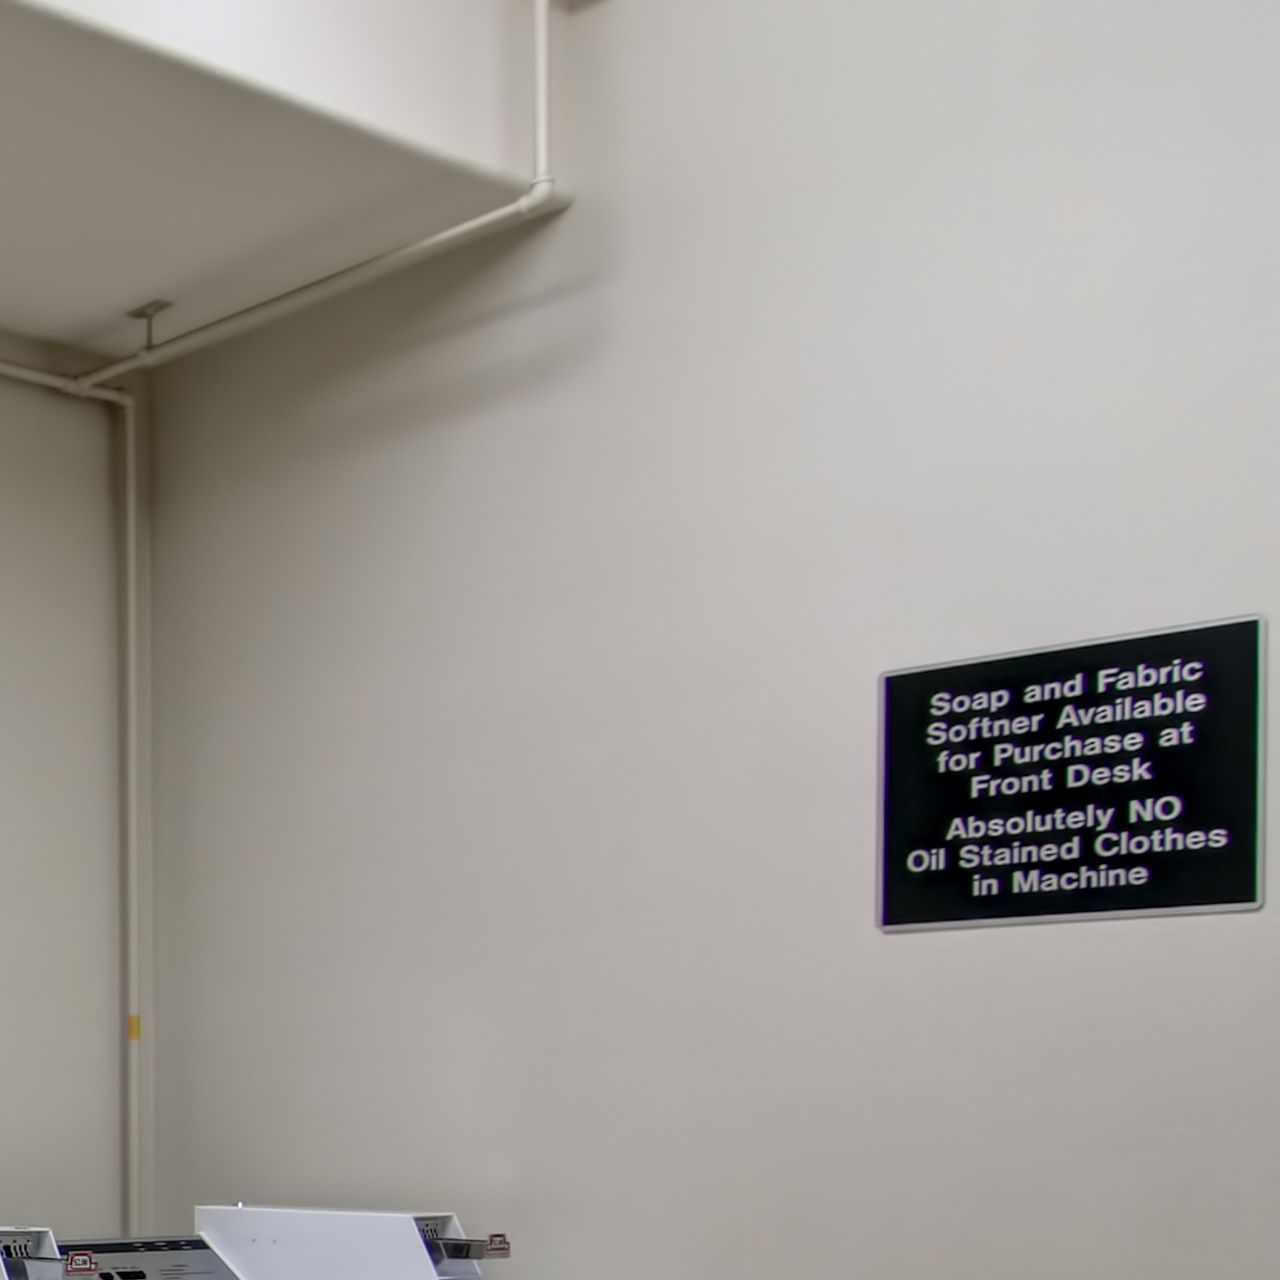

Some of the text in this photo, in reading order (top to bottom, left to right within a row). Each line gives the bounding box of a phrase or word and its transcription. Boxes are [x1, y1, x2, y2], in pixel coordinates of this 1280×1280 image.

[929, 658, 1204, 716] Soap and Fabric
[926, 689, 1208, 746] Softner Available
[936, 721, 1195, 774] for Purchase at
[970, 757, 1153, 799] Front Desk
[945, 795, 1183, 841] Absolutely NO
[905, 826, 1229, 873] Oil Stained Clothes
[971, 863, 1150, 897] in Machine
